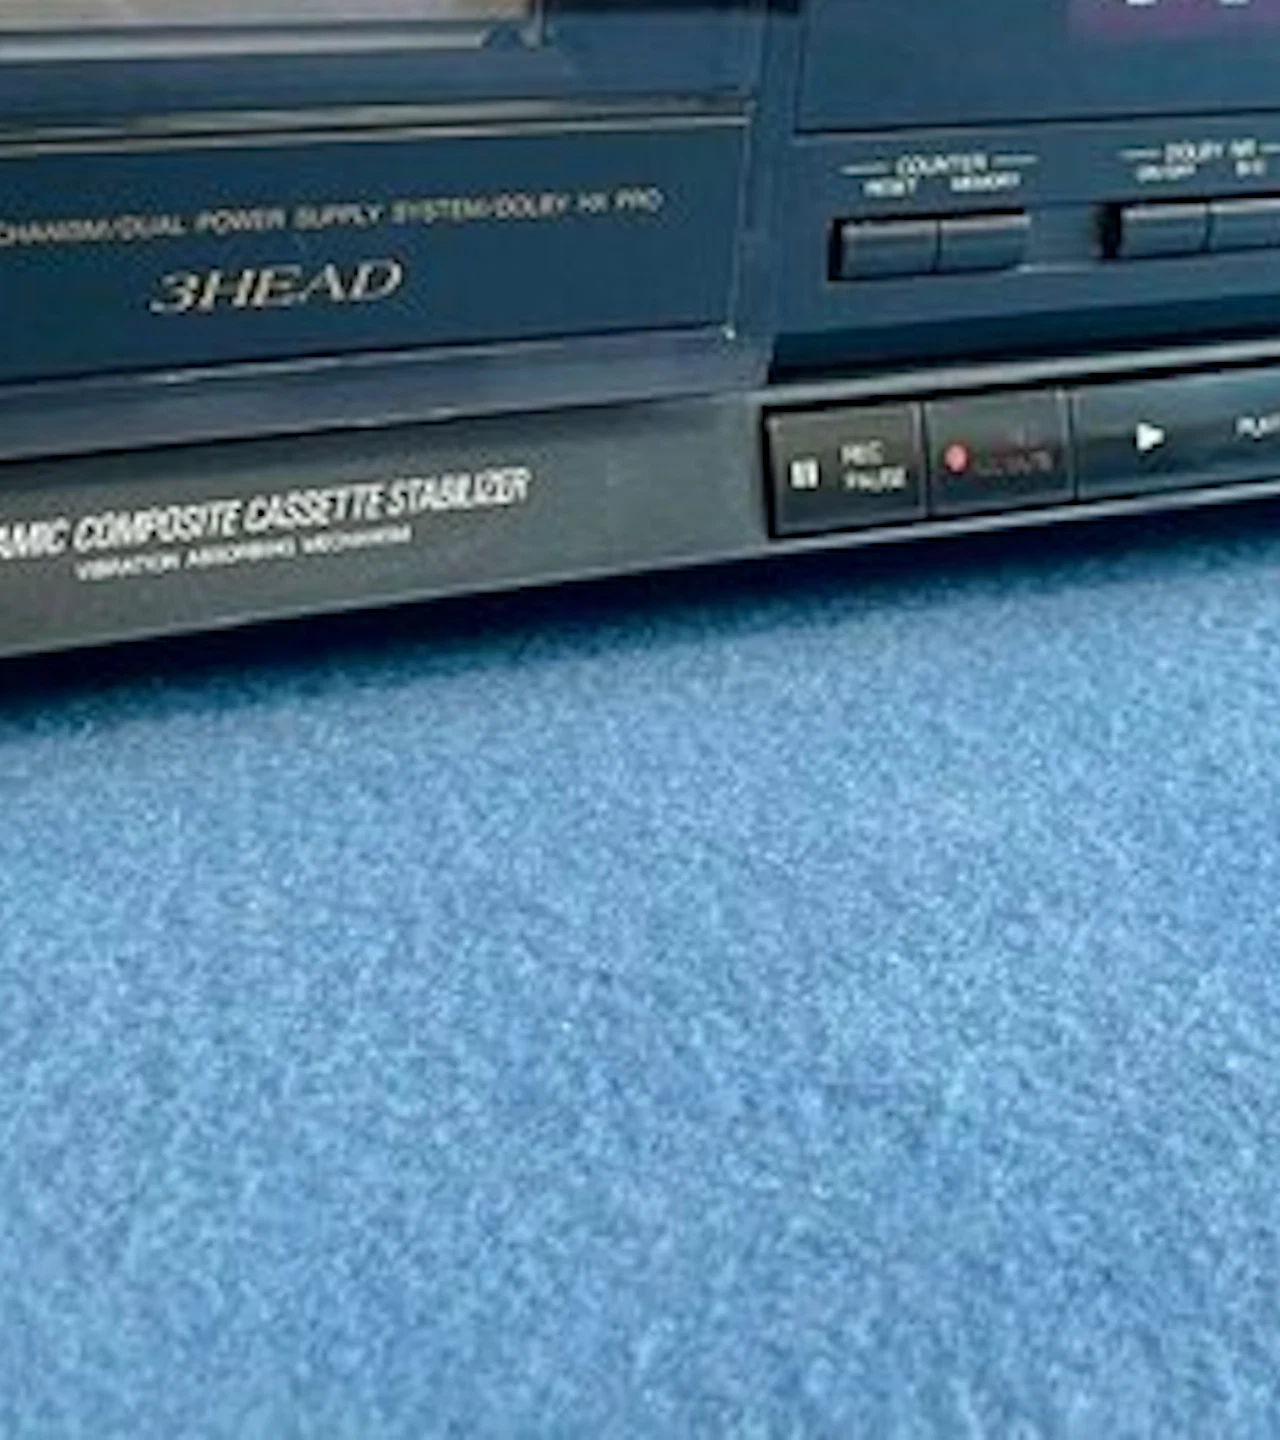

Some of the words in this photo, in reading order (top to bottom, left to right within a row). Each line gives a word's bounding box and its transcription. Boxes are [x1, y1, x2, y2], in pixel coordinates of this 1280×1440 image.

[895, 153, 988, 176] COUNTER
[194, 206, 287, 234] POWER
[293, 201, 384, 230] SUPPLY
[390, 192, 570, 225] SYSTEM/DOLBY
[613, 186, 666, 214] PRO
[149, 258, 405, 315] 3HEAD
[73, 501, 244, 553] COMPOSITE
[243, 481, 387, 534] CASSETTE
[384, 467, 532, 517] STABILIZER
